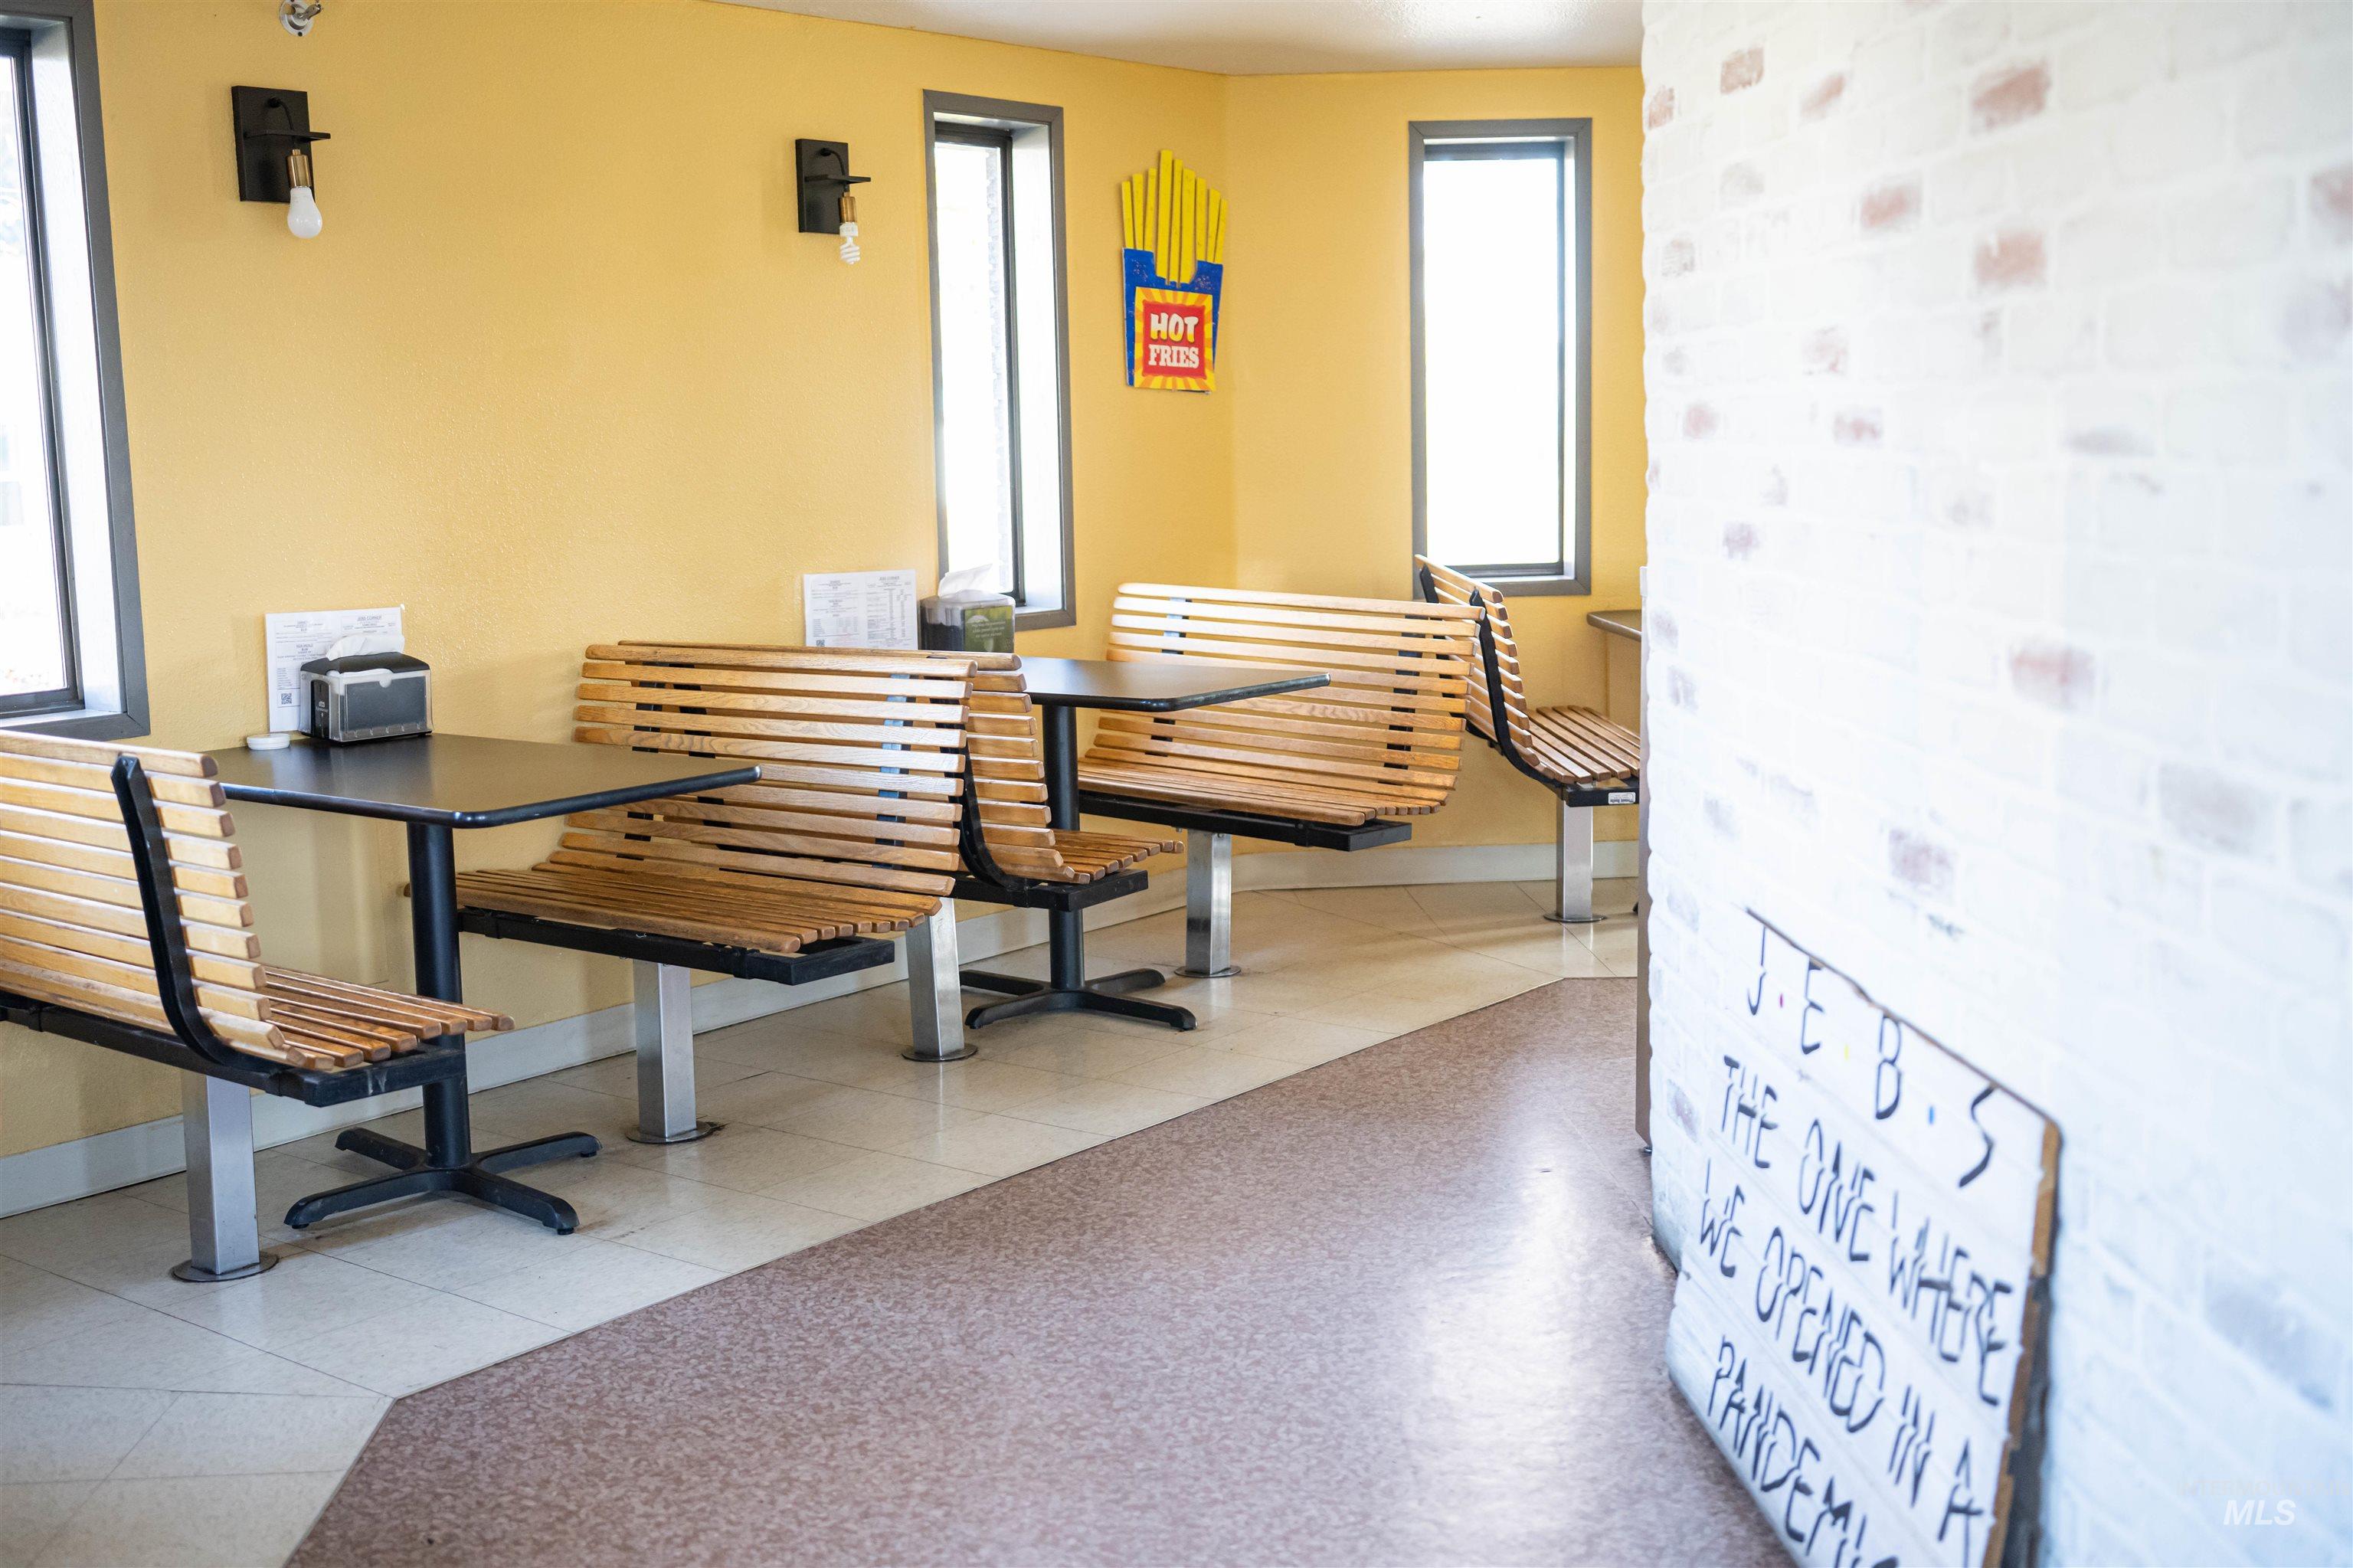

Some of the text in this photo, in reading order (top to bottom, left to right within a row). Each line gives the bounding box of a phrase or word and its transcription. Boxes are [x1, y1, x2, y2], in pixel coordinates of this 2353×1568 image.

[1148, 344, 1199, 368] FRIES
[1150, 313, 1199, 343] HOT
[1722, 1055, 2014, 1406] THE ONE WHERE
[1700, 1158, 1984, 1568] WE OPENED IN A
[1708, 1335, 1898, 1568] PANDEMI
